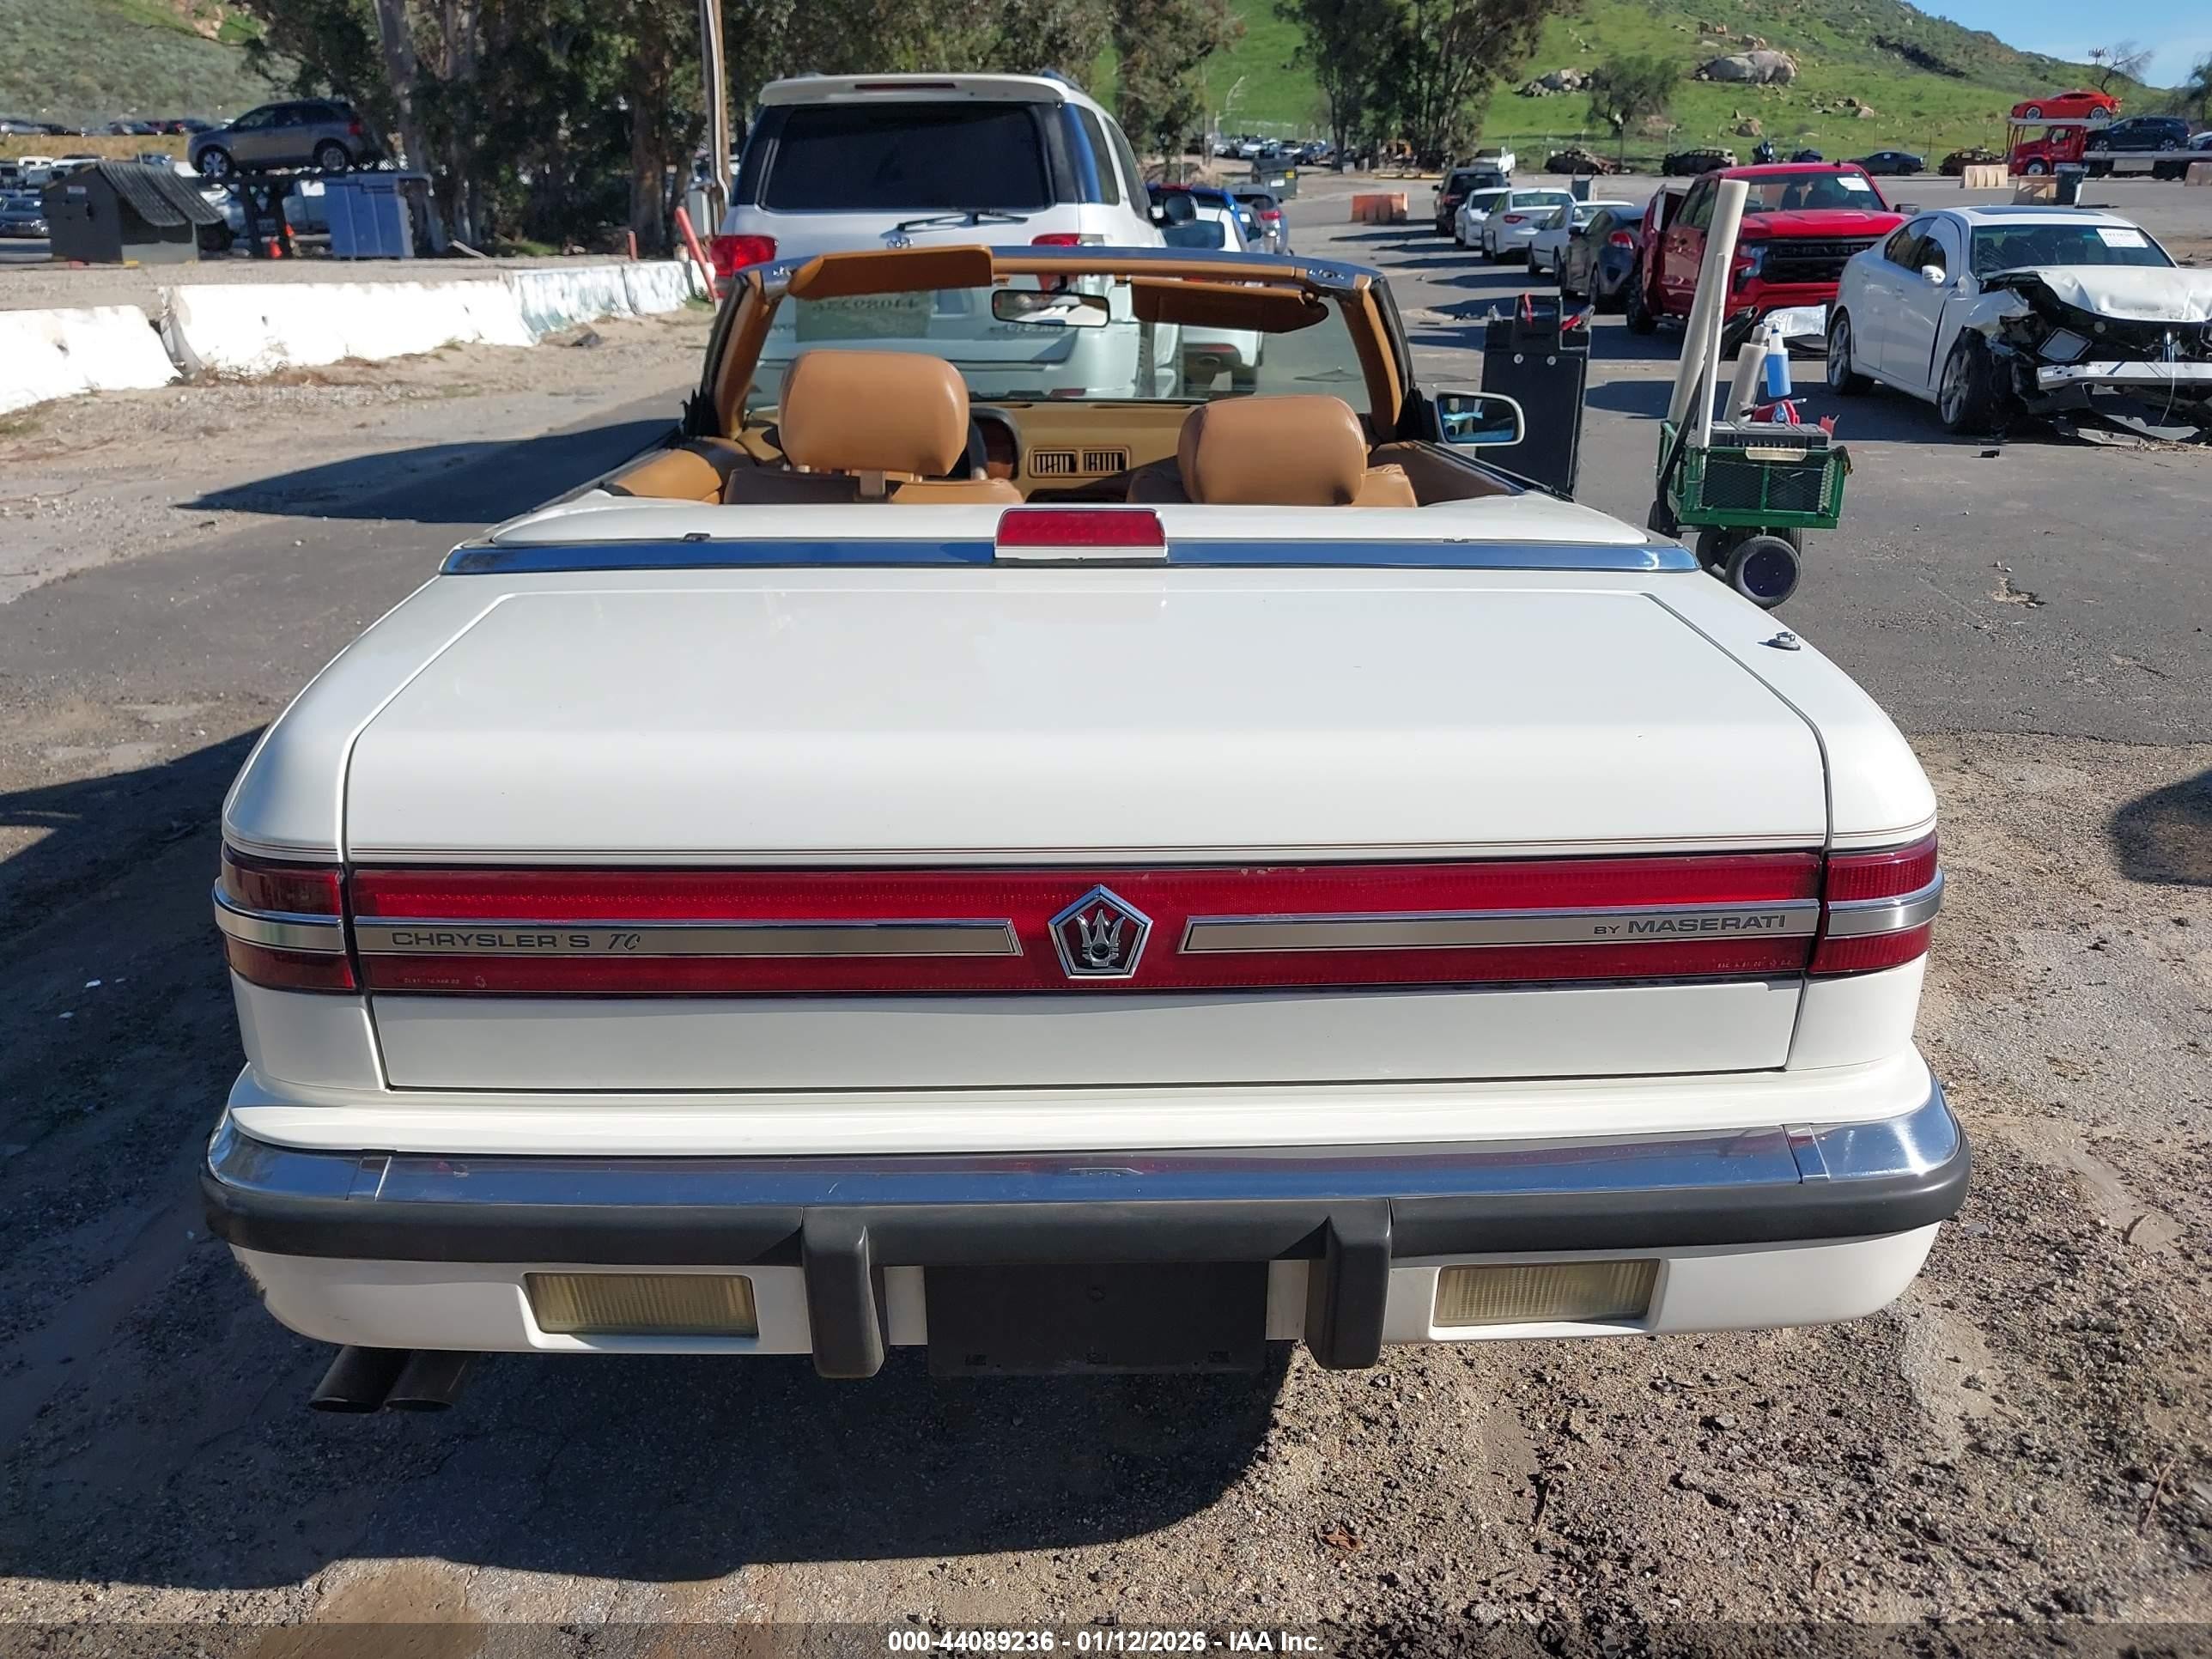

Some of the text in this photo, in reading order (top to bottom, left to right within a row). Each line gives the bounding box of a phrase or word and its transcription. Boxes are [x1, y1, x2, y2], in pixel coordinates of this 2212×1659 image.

[1593, 915, 1786, 935] BY MASERATI
[391, 931, 641, 951] CHRYSLER'S TC
